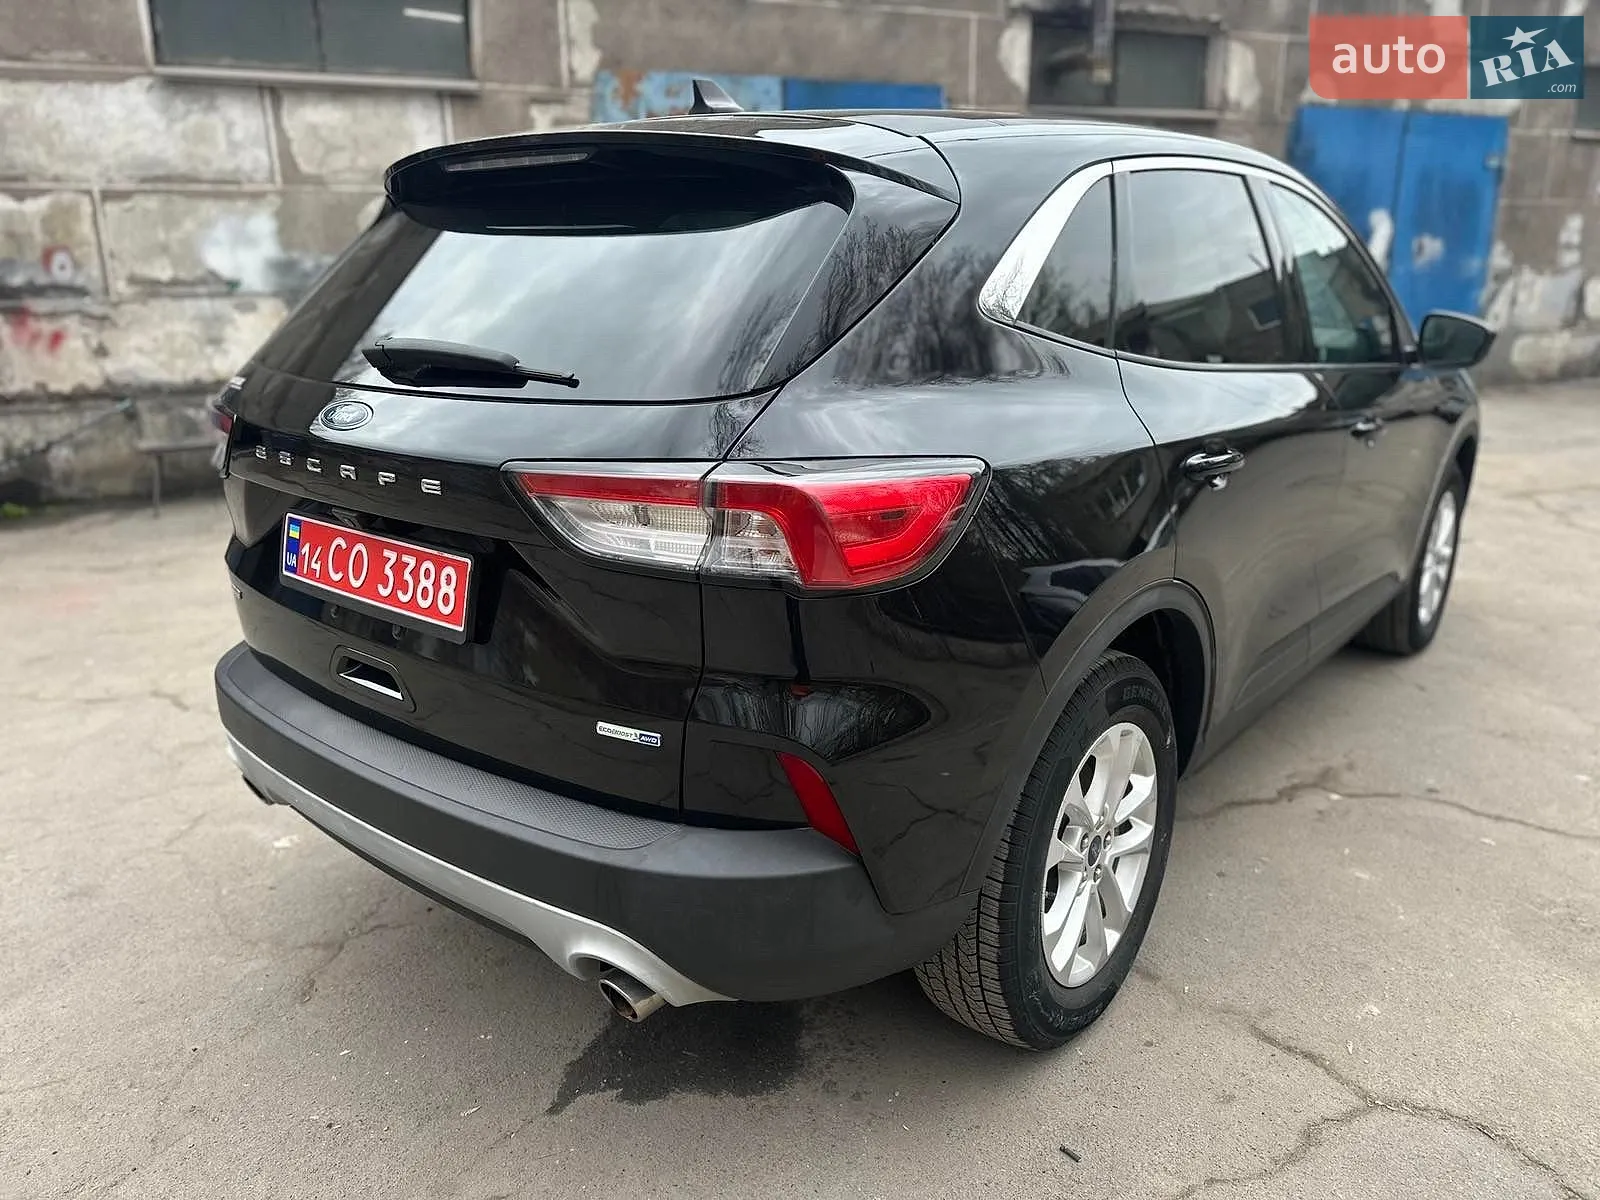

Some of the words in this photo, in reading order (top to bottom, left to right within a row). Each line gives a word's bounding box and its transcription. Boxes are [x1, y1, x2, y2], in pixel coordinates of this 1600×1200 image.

[255, 444, 443, 496] ESCAPE
[286, 552, 297, 568] UA
[301, 542, 323, 579] 14
[327, 536, 369, 589] CO
[376, 548, 458, 616] 3388
[640, 735, 658, 744] AWD
